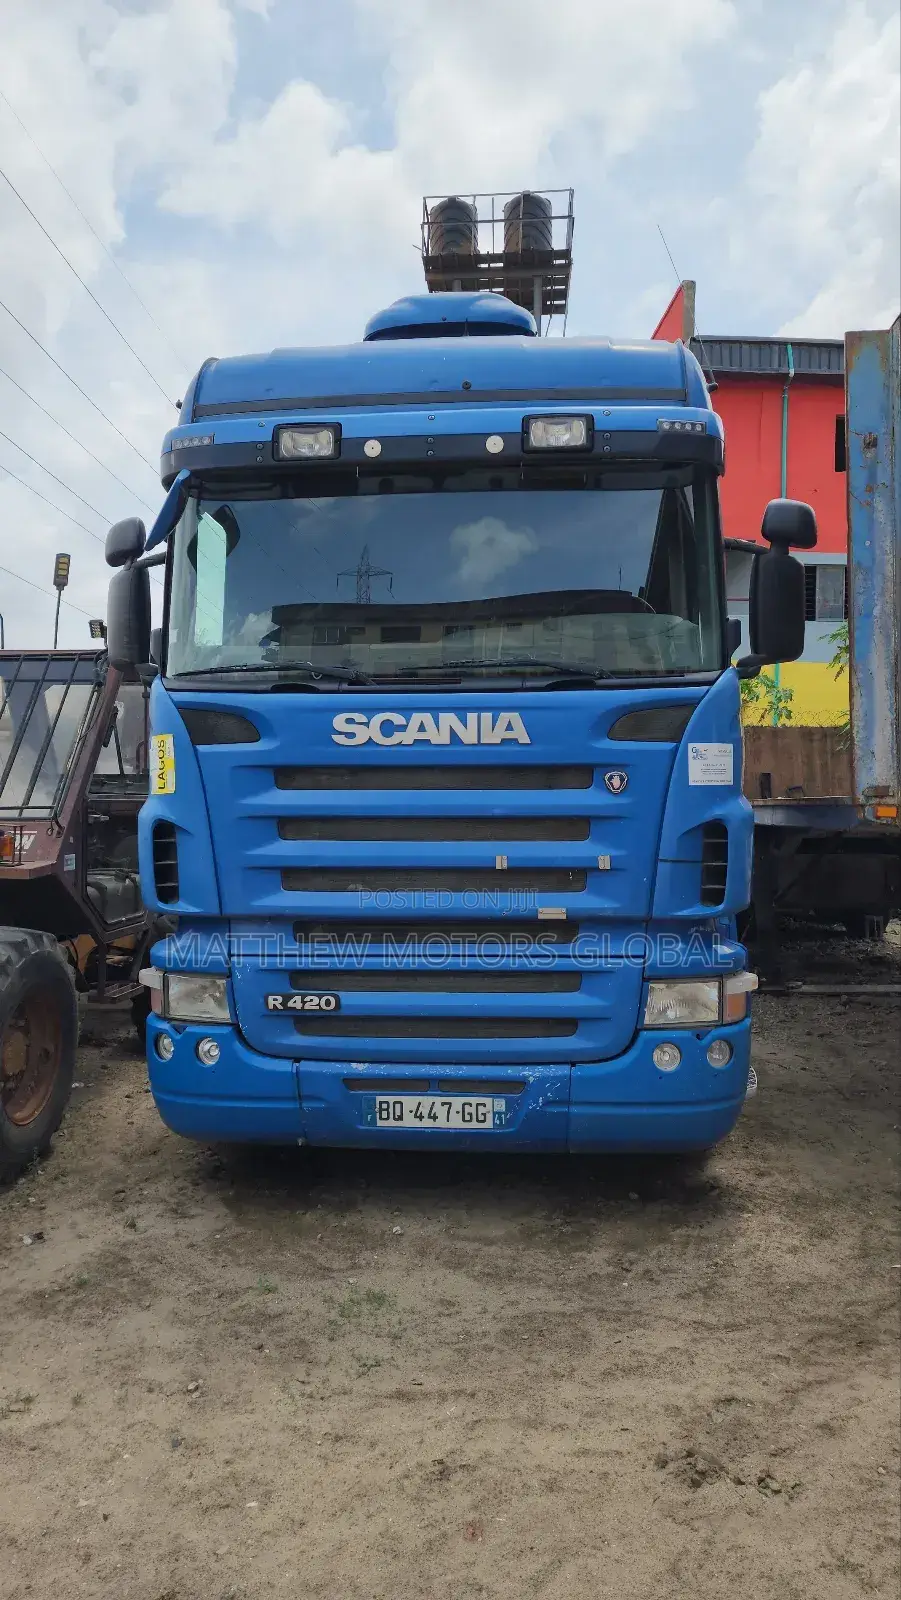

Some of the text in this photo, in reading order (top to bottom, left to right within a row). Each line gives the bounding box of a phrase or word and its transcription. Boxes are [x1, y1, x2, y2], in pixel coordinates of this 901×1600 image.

[331, 712, 531, 745] SCANIA
[157, 739, 165, 789] LAGOS
[267, 995, 336, 1011] R 420
[494, 1113, 506, 1125] 41
